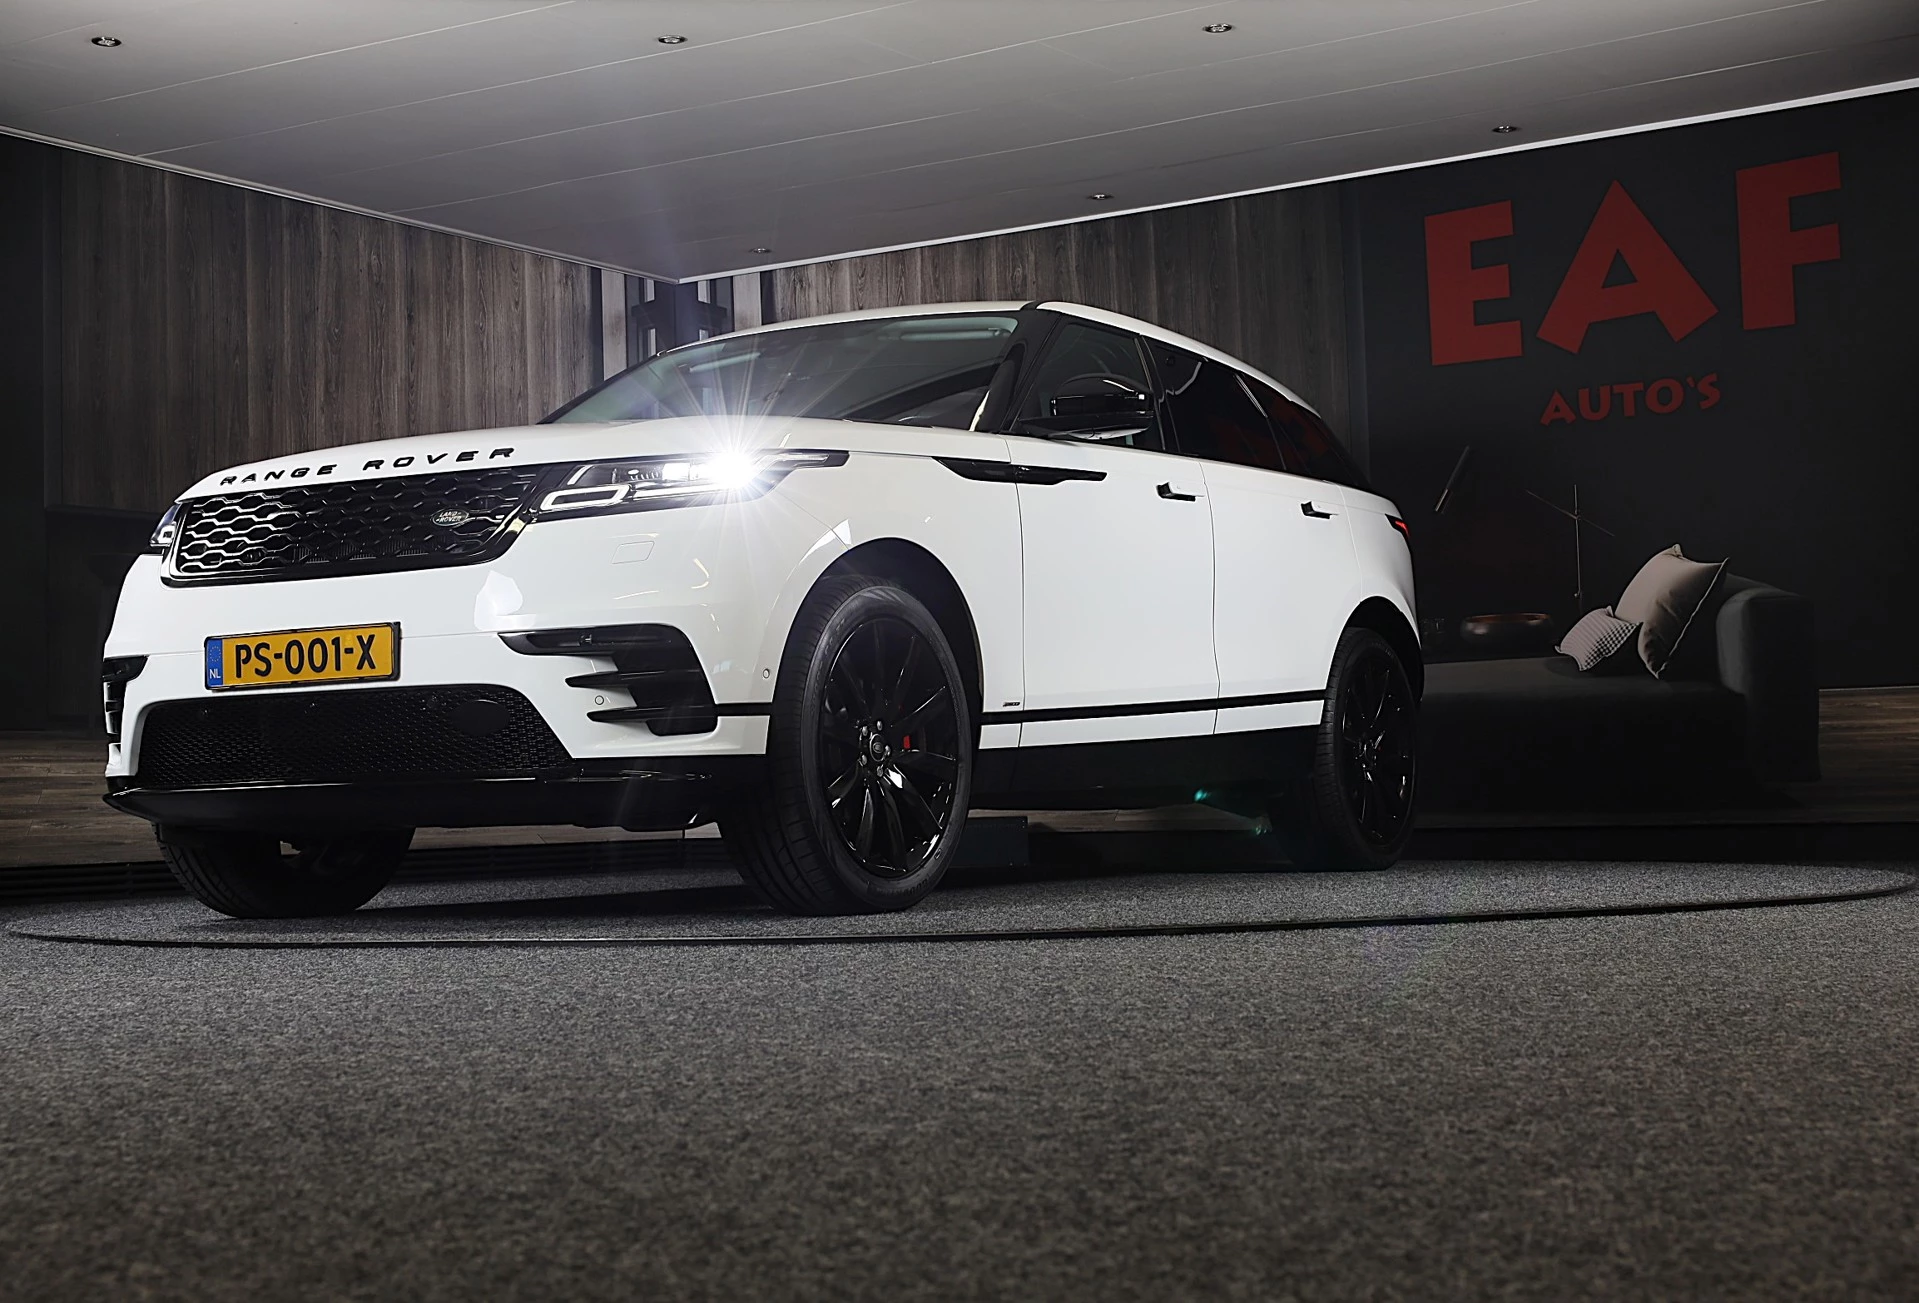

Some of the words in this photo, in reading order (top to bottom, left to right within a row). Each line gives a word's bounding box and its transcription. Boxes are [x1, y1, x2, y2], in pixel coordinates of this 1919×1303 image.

[1424, 151, 1842, 366] EAF
[1540, 373, 1721, 427] AUTO'S
[219, 463, 338, 486] RANGE
[362, 447, 515, 472] ROVER
[209, 668, 222, 680] NL
[235, 634, 376, 678] PS-001-X
